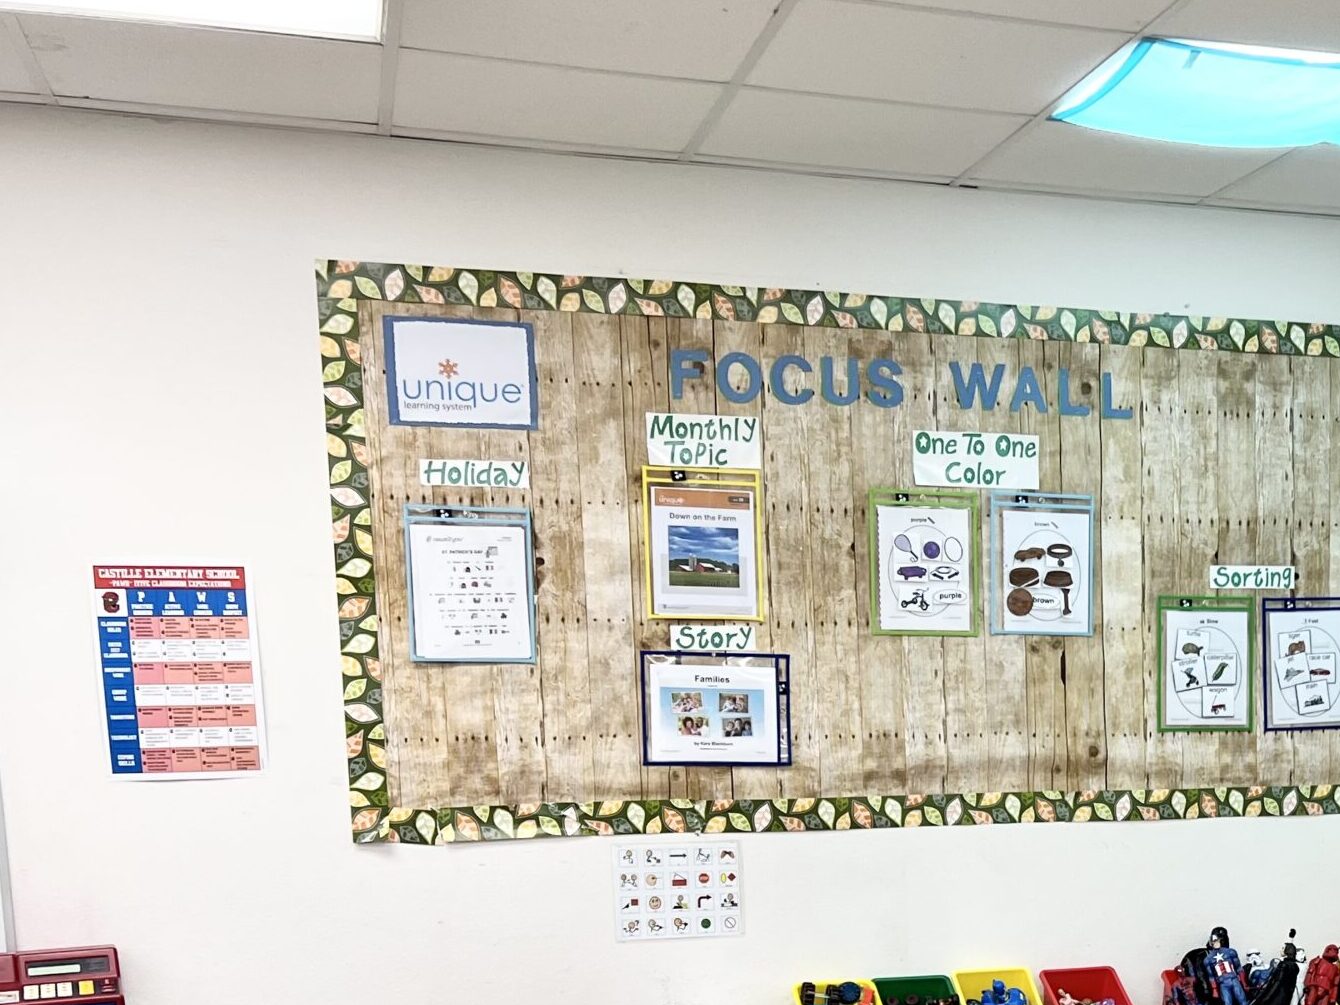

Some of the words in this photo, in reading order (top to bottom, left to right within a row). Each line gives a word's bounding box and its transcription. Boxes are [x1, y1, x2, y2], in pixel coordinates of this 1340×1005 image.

[403, 379, 522, 408] unique
[670, 349, 905, 409] FOCUS
[949, 361, 1134, 420] WALL
[403, 401, 440, 411] learning
[442, 403, 472, 412] system
[650, 415, 757, 443] Monthly
[915, 431, 957, 455] One
[962, 433, 985, 456] To
[995, 434, 1037, 458] One
[423, 460, 525, 487] Holiday
[945, 461, 1006, 486] Color
[669, 512, 691, 520] Down
[717, 514, 737, 522] Farm
[1213, 566, 1292, 589] Sorting
[196, 591, 207, 603] W
[227, 591, 237, 603] S
[939, 593, 962, 602] purple
[676, 626, 752, 649] Story
[695, 675, 730, 683] Families
